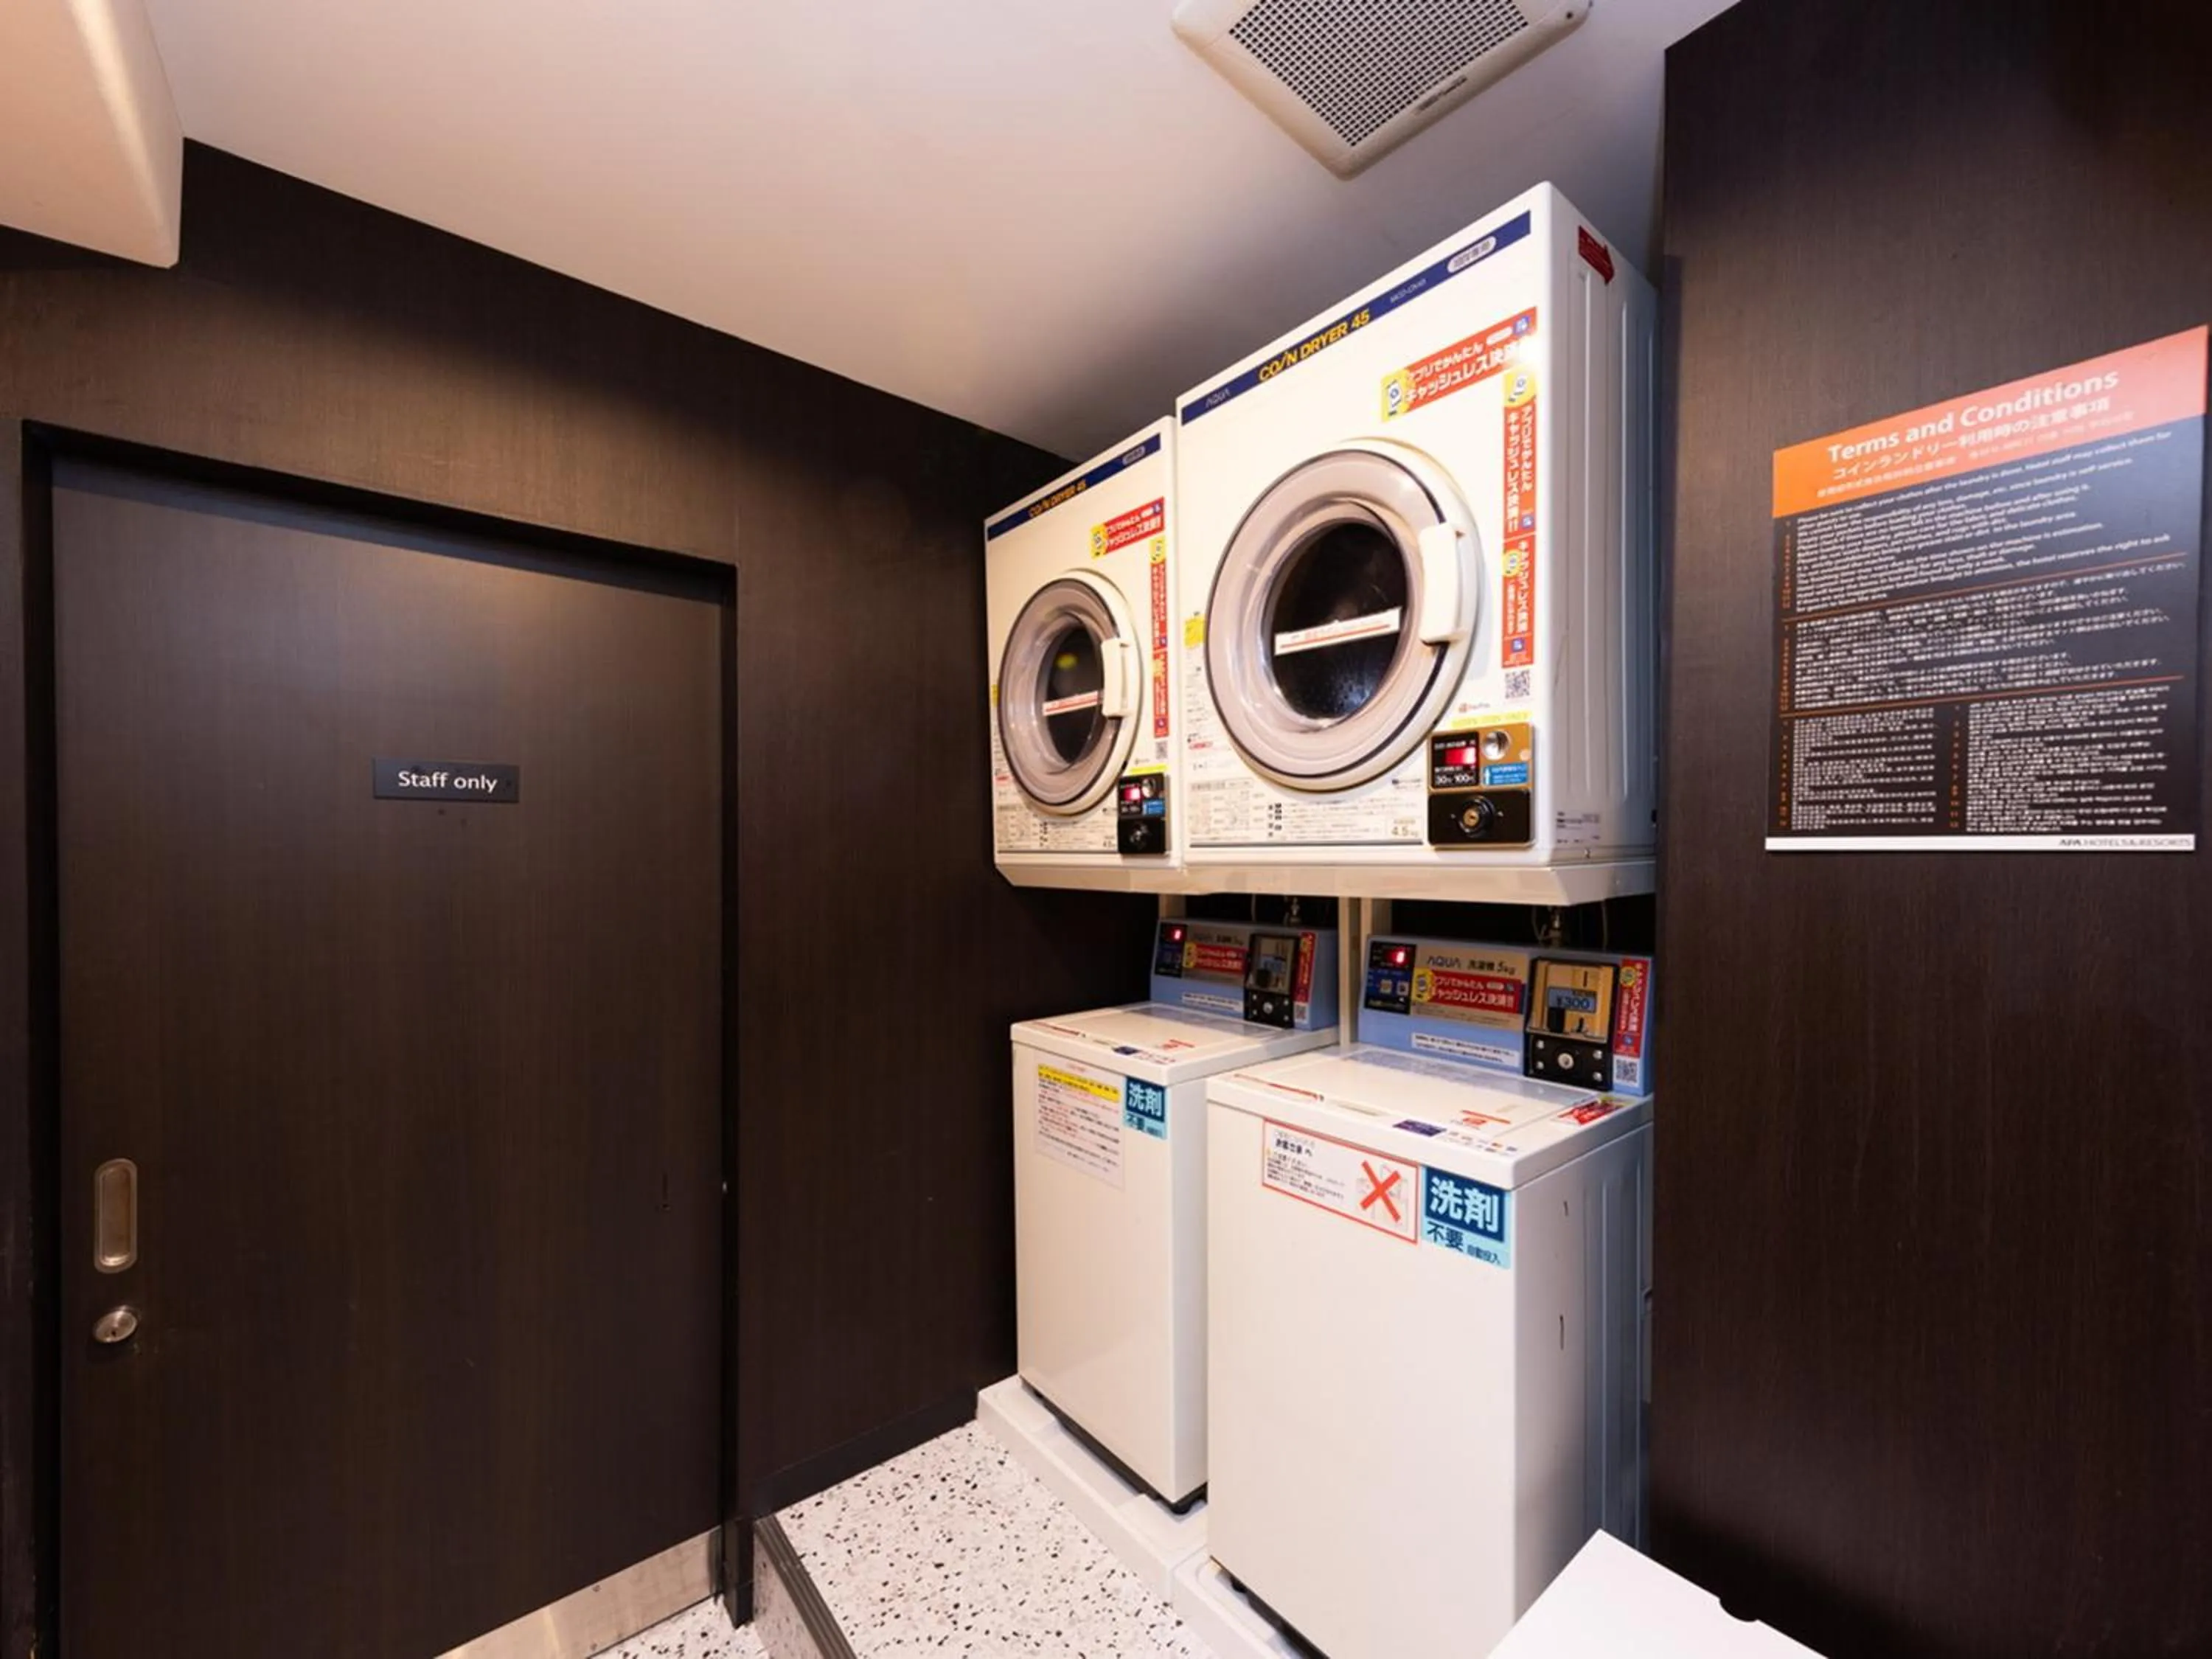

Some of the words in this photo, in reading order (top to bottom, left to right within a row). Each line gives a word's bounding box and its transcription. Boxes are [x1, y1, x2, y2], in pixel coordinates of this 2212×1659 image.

[1300, 323, 1349, 360] DRYER
[1351, 308, 1371, 328] 45
[1827, 432, 1899, 463] Terms
[1905, 413, 1954, 441] and
[1959, 370, 2119, 428] Conditions
[1832, 397, 2111, 479] コインランドリー利用時の注意事項
[398, 771, 450, 788] Staff
[453, 775, 498, 794] only
[1427, 956, 1461, 969] AQUA
[1127, 1082, 1163, 1117] 洗剤
[1430, 1175, 1499, 1234] 洗剤
[1427, 1220, 1464, 1253] 不要
